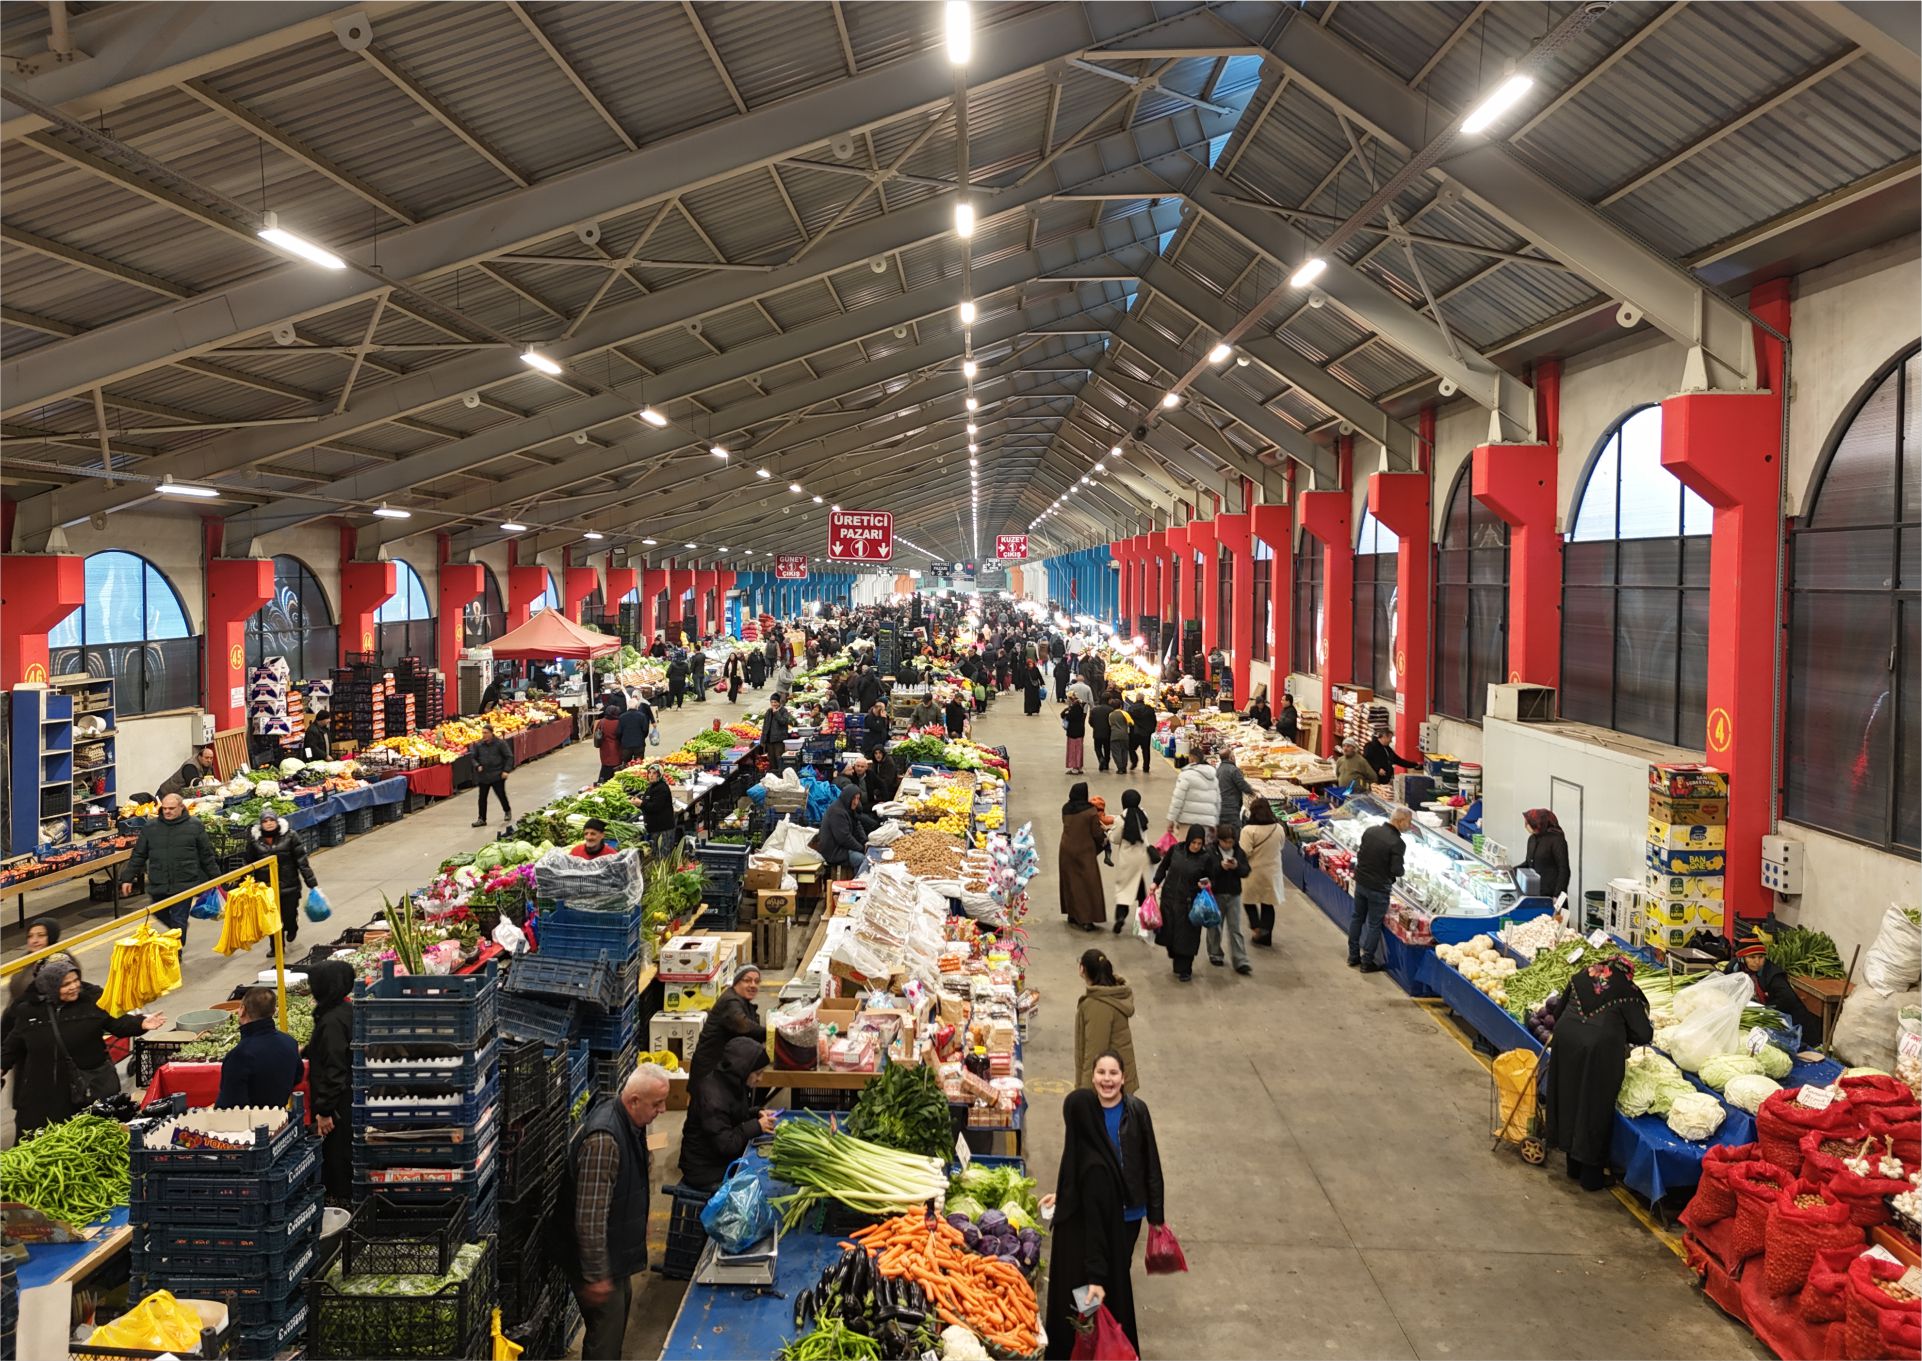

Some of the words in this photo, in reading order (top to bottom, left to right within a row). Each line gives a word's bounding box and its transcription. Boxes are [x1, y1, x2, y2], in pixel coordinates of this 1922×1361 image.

[834, 513, 888, 527] ÜRETİCİ
[840, 528, 883, 540] PAZARI
[854, 540, 864, 558] 1
[232, 649, 242, 666] 45
[28, 669, 43, 684] 46
[1715, 717, 1725, 745] 4
[1689, 855, 1706, 863] BAN
[1689, 862, 1705, 870] ONE
